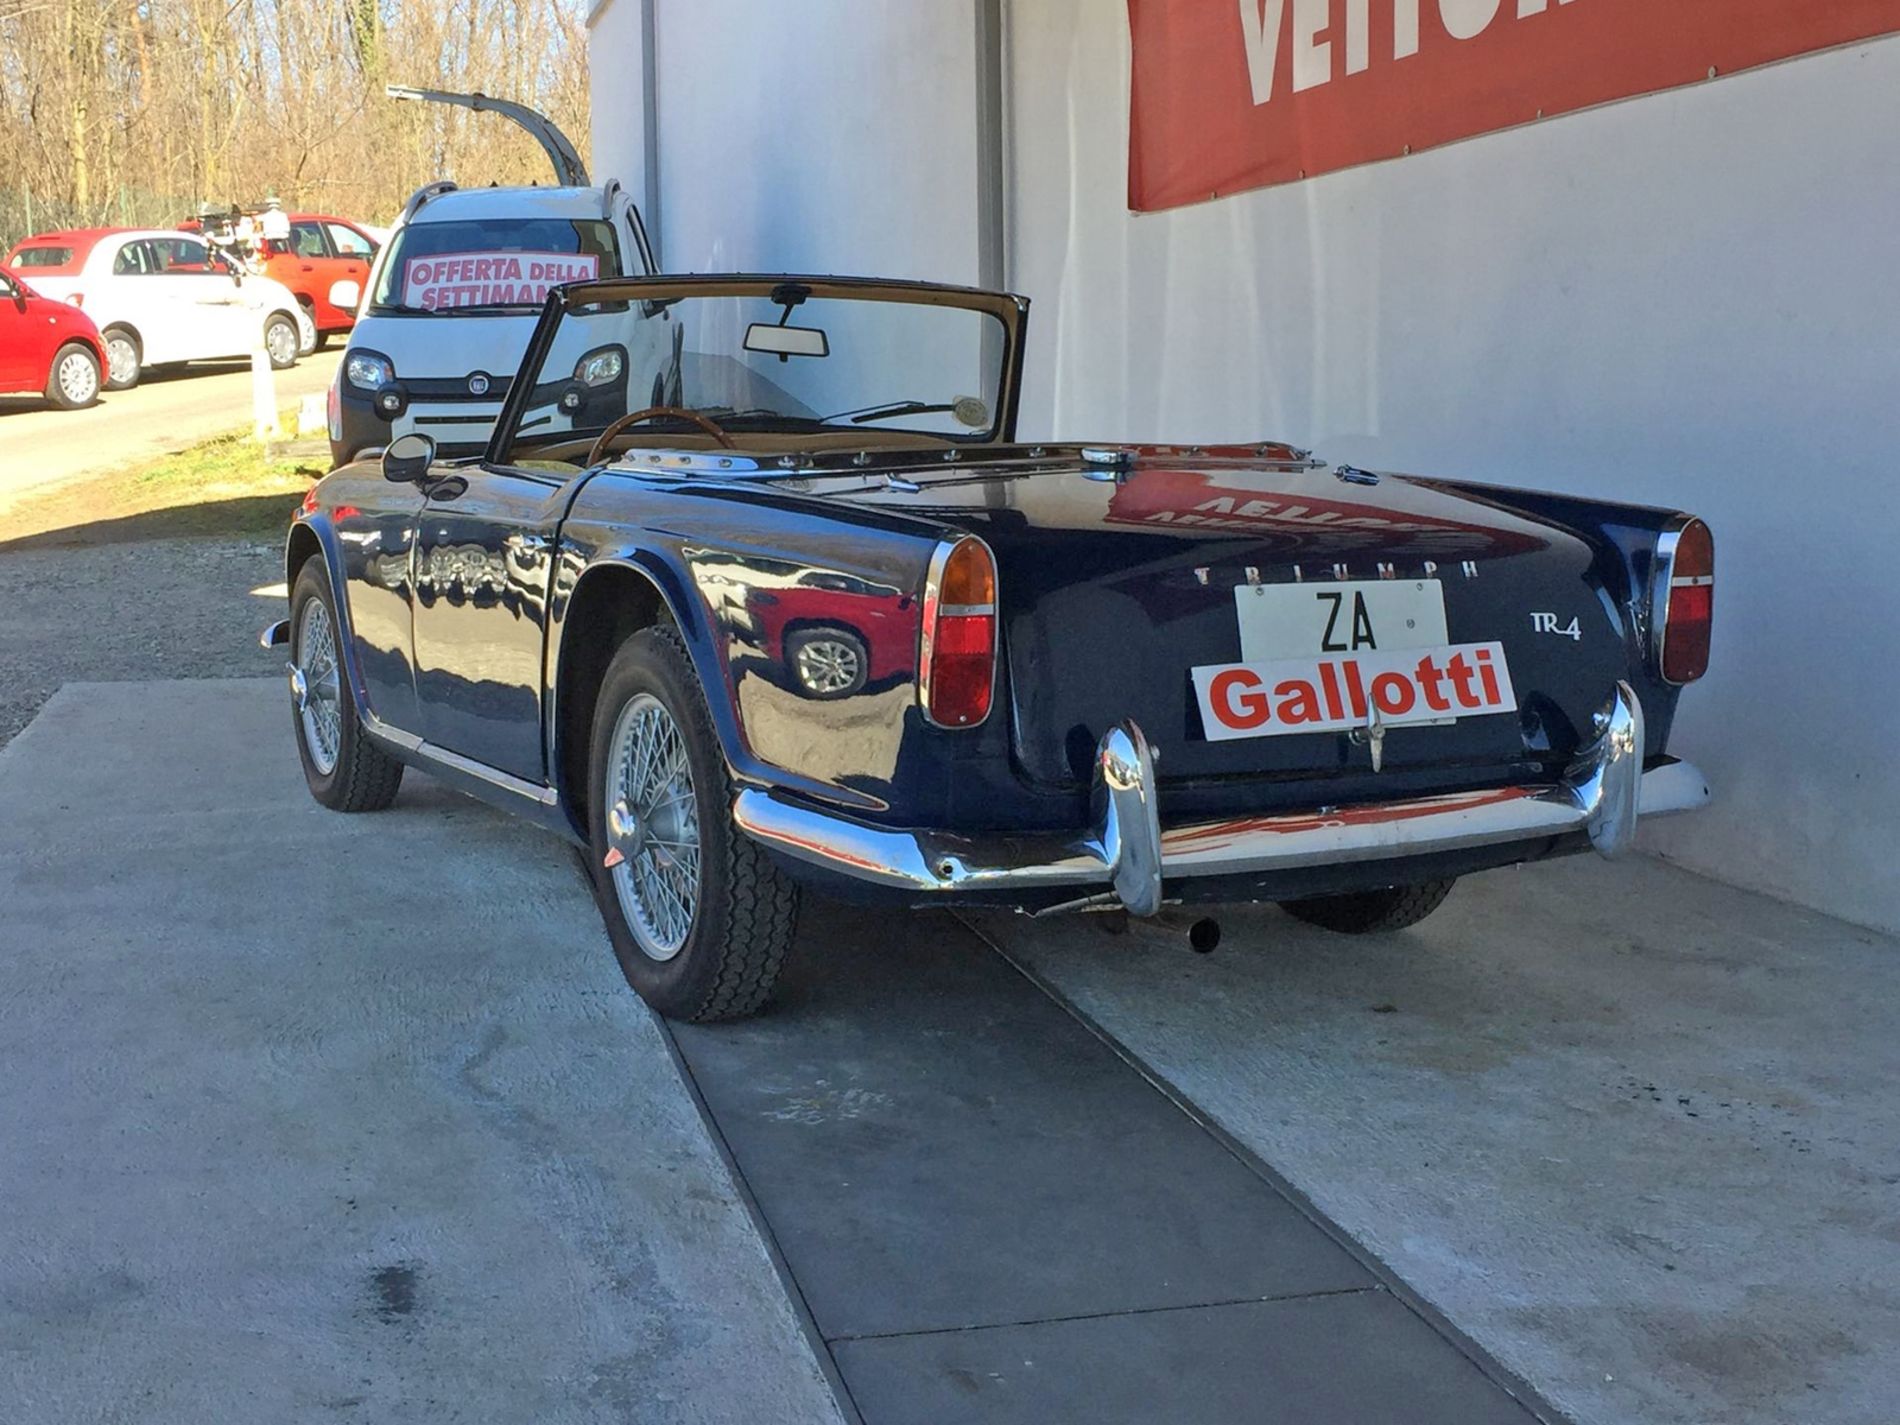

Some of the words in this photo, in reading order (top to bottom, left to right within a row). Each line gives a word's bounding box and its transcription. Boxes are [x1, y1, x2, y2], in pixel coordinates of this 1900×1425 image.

[411, 258, 523, 286] OFFERTA
[530, 262, 590, 281] DELLA
[1194, 560, 1479, 585] TRIUMPH
[1316, 591, 1377, 651] ZA
[1529, 612, 1581, 640] TR4
[1209, 649, 1502, 730] Gallotti
